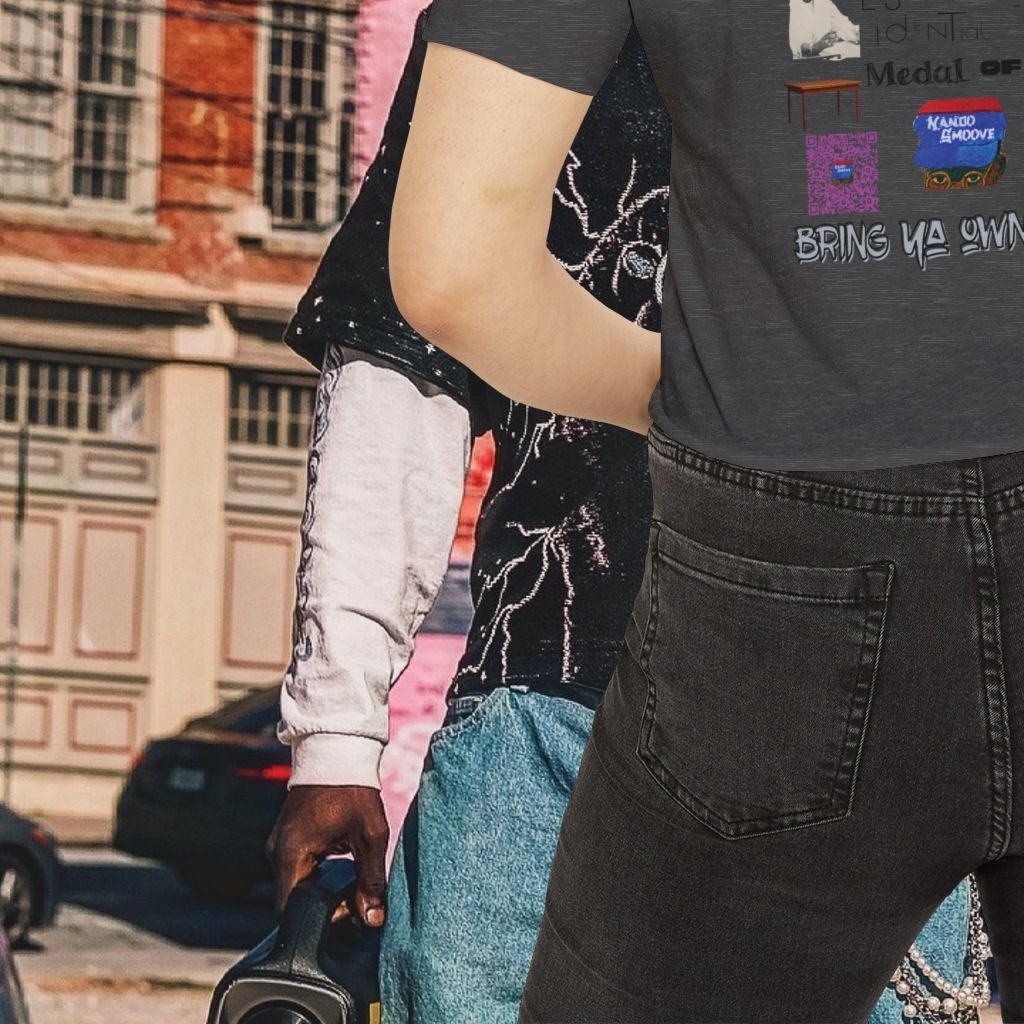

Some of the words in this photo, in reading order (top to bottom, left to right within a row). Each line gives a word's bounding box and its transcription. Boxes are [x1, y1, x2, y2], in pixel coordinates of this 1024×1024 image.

[867, 57, 970, 88] Medal
[980, 59, 1022, 76] OF
[926, 115, 976, 131] NANDO
[795, 220, 891, 264] BRING
[900, 218, 950, 272] YA
